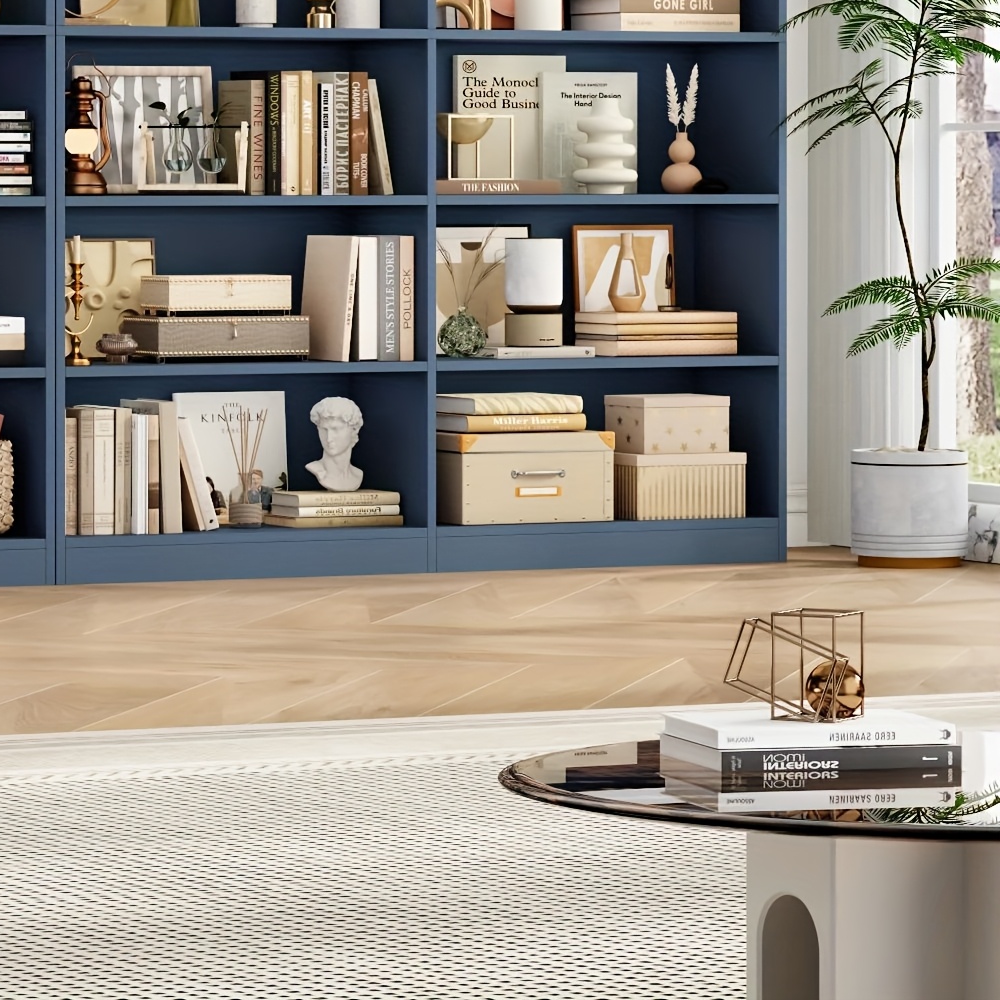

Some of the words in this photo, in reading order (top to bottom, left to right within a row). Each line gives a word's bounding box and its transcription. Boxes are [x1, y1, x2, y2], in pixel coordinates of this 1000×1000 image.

[462, 76, 488, 88] The
[462, 88, 500, 98] Guide
[505, 89, 516, 98] to
[254, 96, 264, 127] FINE
[270, 74, 280, 126] WINDOWS
[302, 100, 312, 119] ART
[335, 77, 349, 147] ПАСТЕРНАК
[351, 81, 360, 120] CHAPMAN
[462, 98, 497, 110] Good
[254, 133, 264, 180] WINES
[335, 150, 349, 188] БОРИС
[360, 153, 368, 170] BOOK
[360, 170, 368, 188] COVER
[462, 183, 481, 192] THE
[482, 183, 520, 192] FASHION
[386, 241, 395, 286] STORIES
[386, 287, 395, 319] STYLE
[402, 268, 412, 330] POLLOCK
[386, 322, 395, 354] MEN'S
[201, 412, 267, 423] KINFOLK
[493, 416, 528, 425] Miller
[531, 416, 569, 424] Harris
[763, 771, 840, 780] INTERIORS
